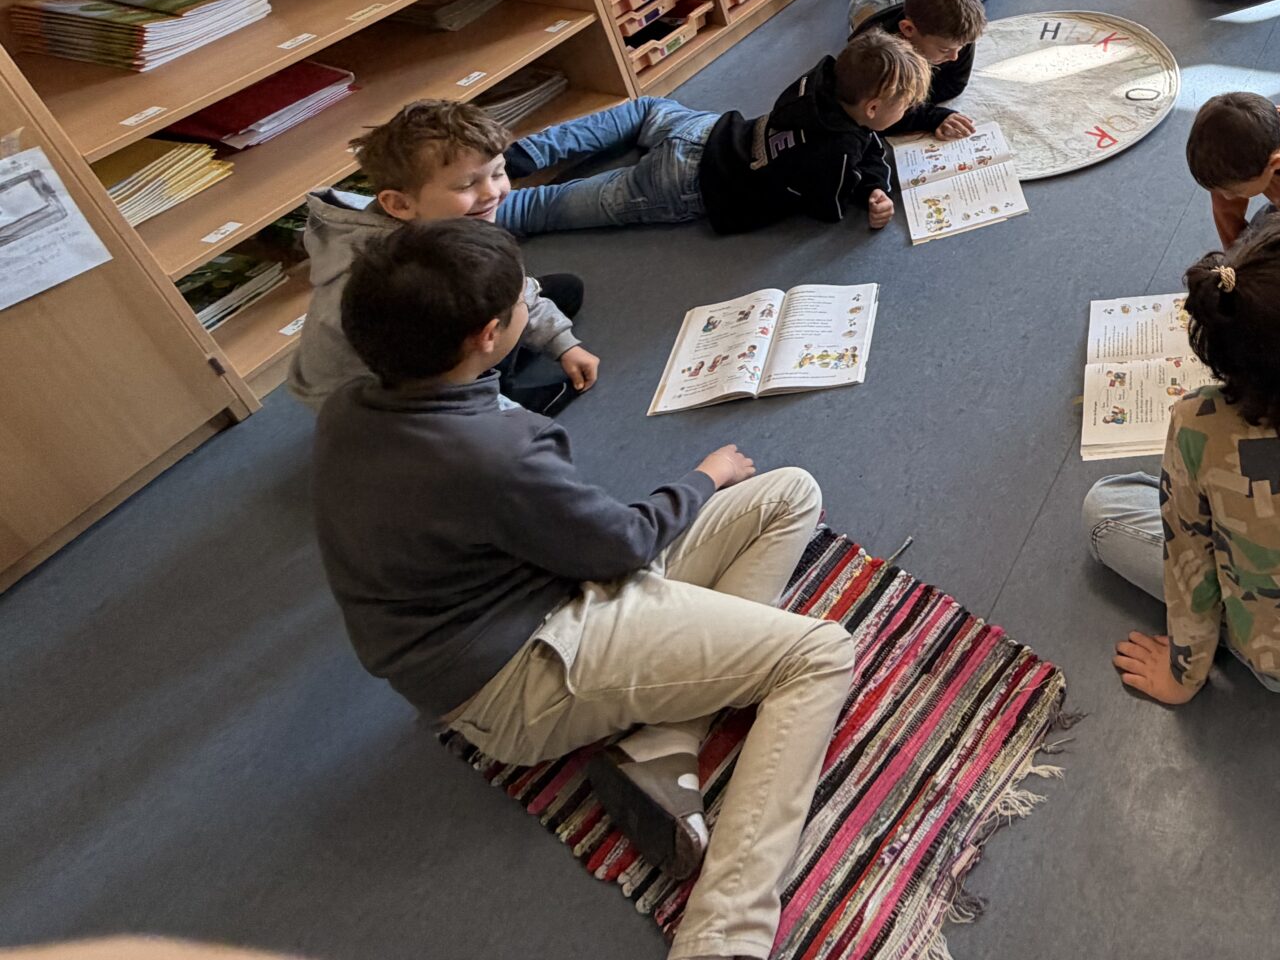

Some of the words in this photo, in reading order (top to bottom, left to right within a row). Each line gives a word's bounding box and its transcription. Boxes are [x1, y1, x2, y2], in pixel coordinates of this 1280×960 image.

[1039, 22, 1062, 40] H
[1093, 31, 1130, 52] K
[1085, 125, 1118, 148] R
